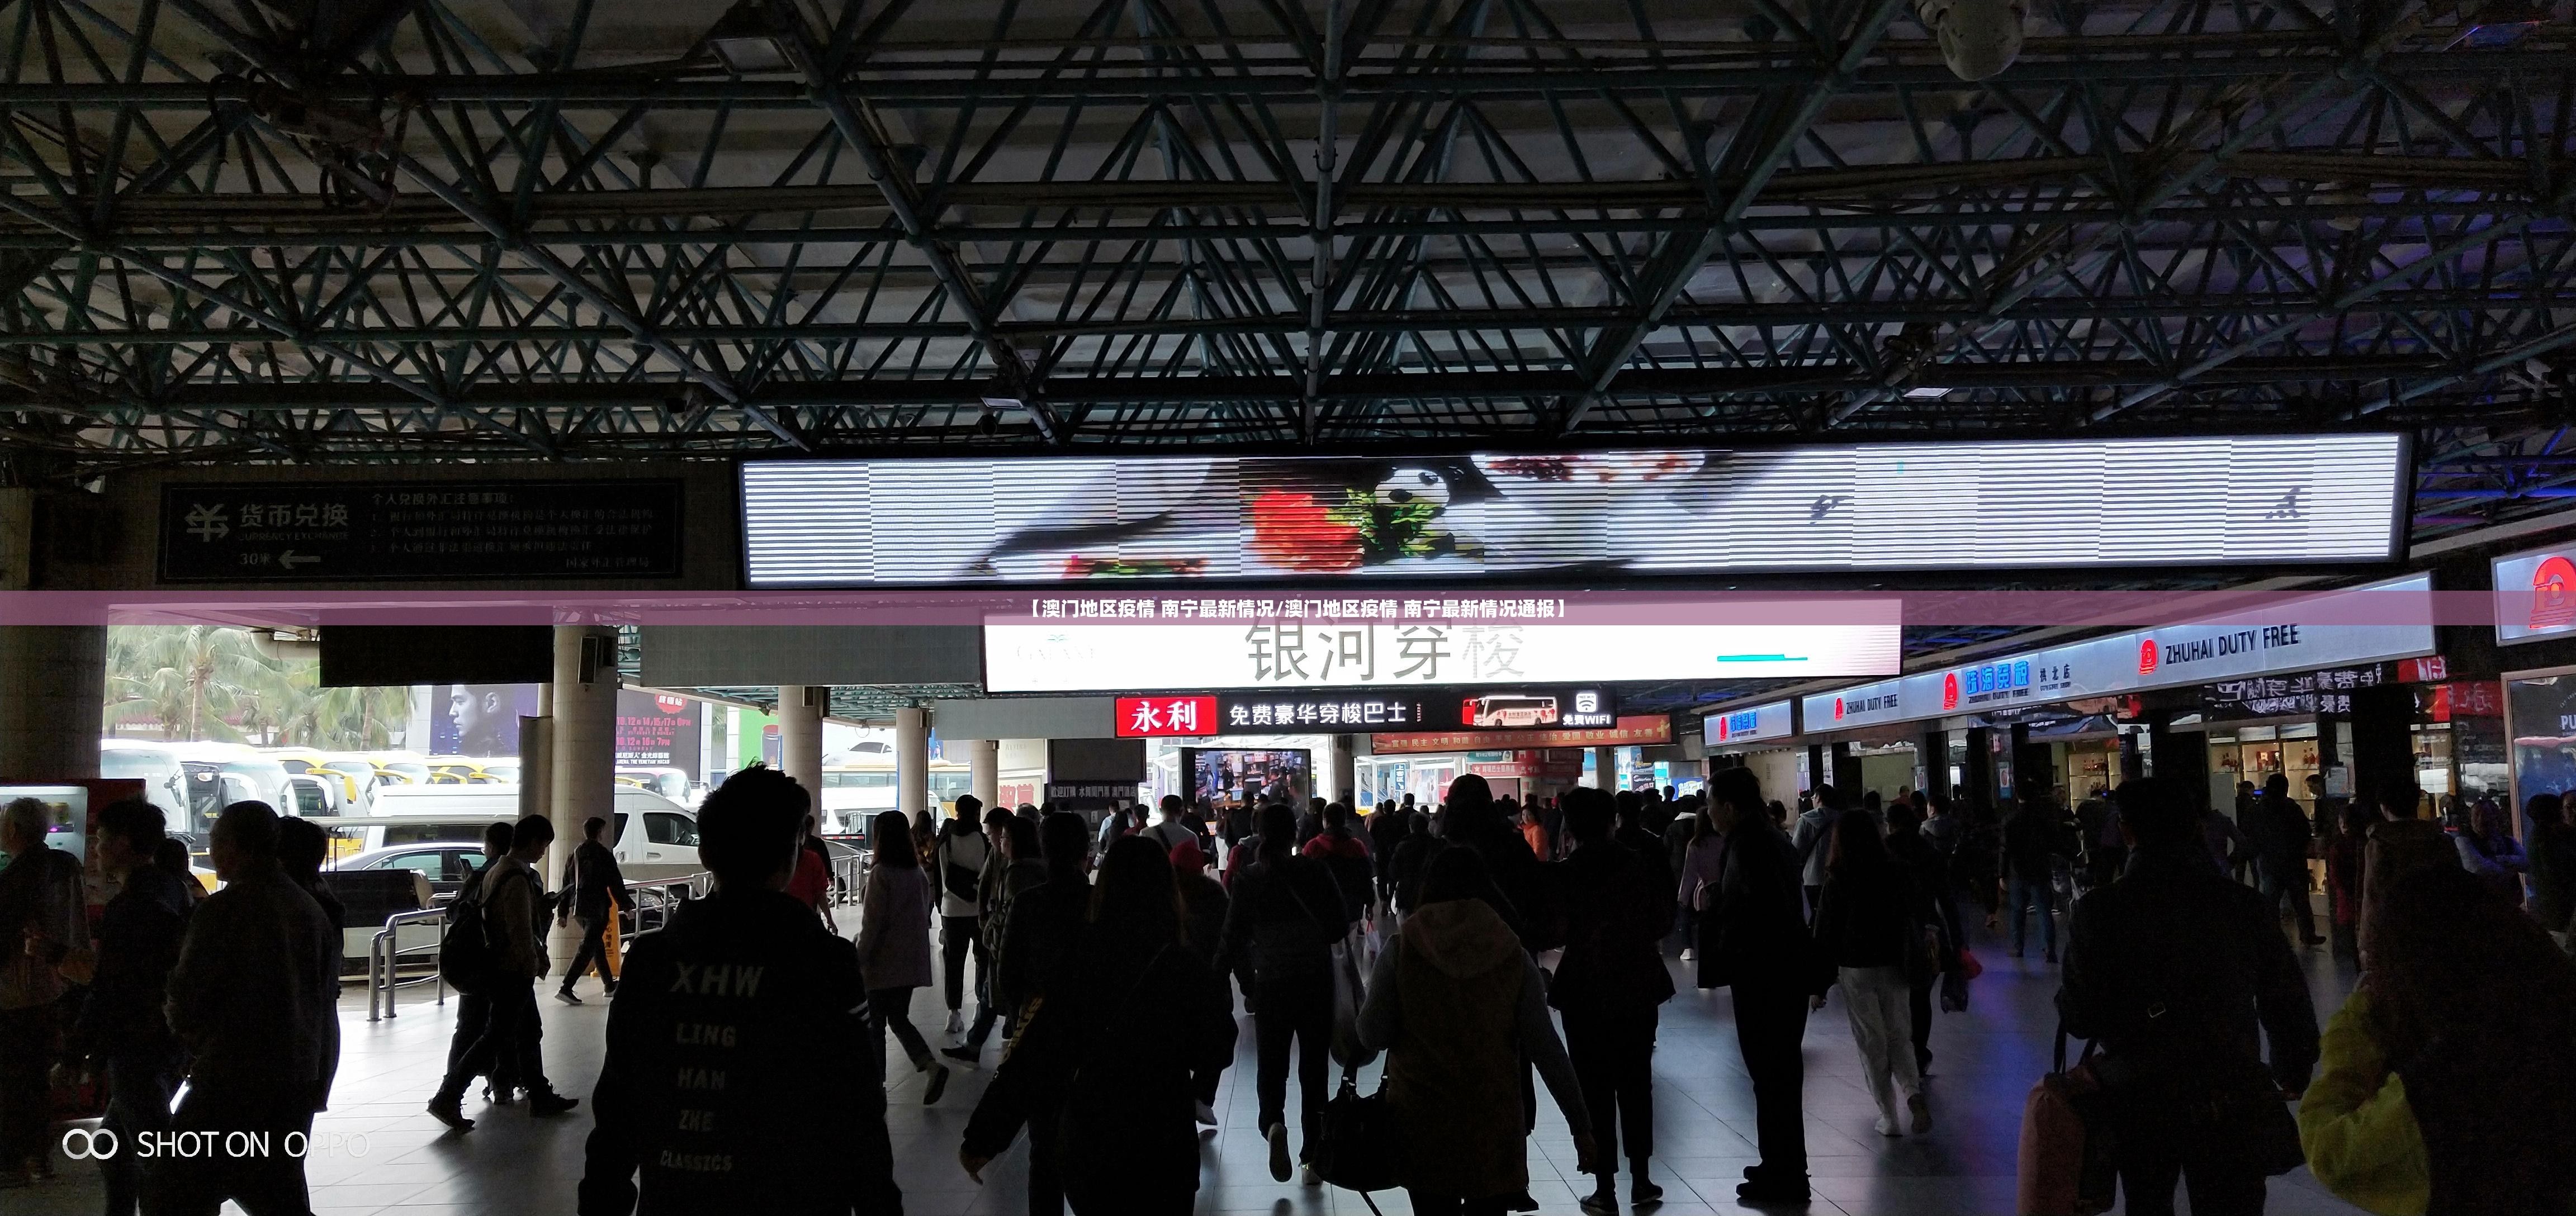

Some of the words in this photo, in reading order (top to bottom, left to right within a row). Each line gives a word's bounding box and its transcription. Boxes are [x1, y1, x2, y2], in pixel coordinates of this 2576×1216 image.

[238, 503, 349, 528] 货币兑换
[2166, 638, 2214, 665] ZHUHAI
[2218, 630, 2257, 656] DUTY
[2264, 623, 2300, 649] FREE
[1966, 661, 2029, 695] 珠海免税
[1130, 700, 1197, 733] 永利
[1230, 702, 1407, 726] 免费豪华穿梭巴士
[1846, 700, 1865, 715] ZHUHAI
[1867, 697, 1882, 712] DUTY
[1883, 694, 1898, 709] FREE
[669, 960, 765, 999] XHW
